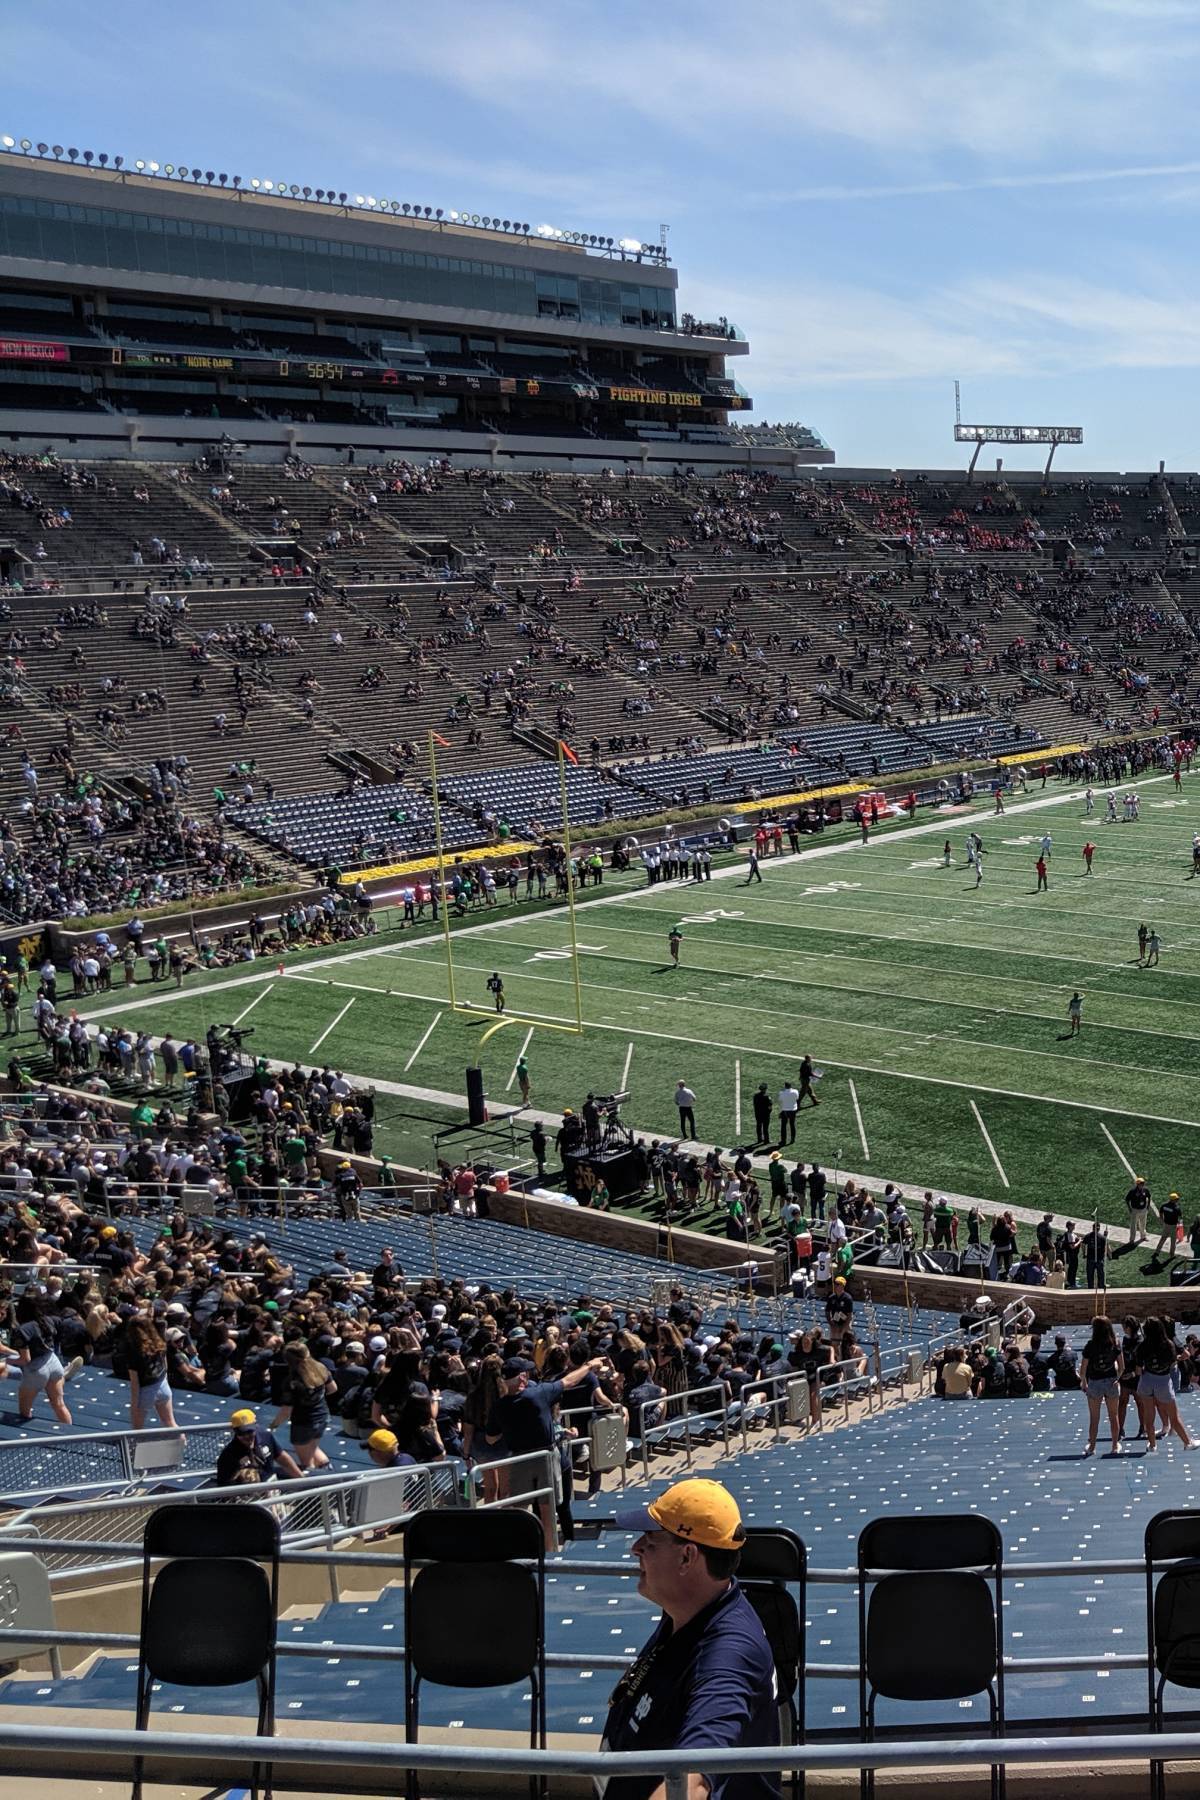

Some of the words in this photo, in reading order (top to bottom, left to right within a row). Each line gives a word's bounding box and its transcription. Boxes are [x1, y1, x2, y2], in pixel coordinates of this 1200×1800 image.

[24, 343, 55, 358] MEXICO
[188, 356, 211, 368] NOTRE
[212, 357, 233, 369] DAME
[307, 363, 343, 380] 56:54
[609, 386, 667, 405] FIGHTING
[668, 391, 702, 407] IRISH
[681, 908, 745, 923] 20
[819, 1260, 826, 1271] 5
[630, 1664, 651, 1692] USHER
